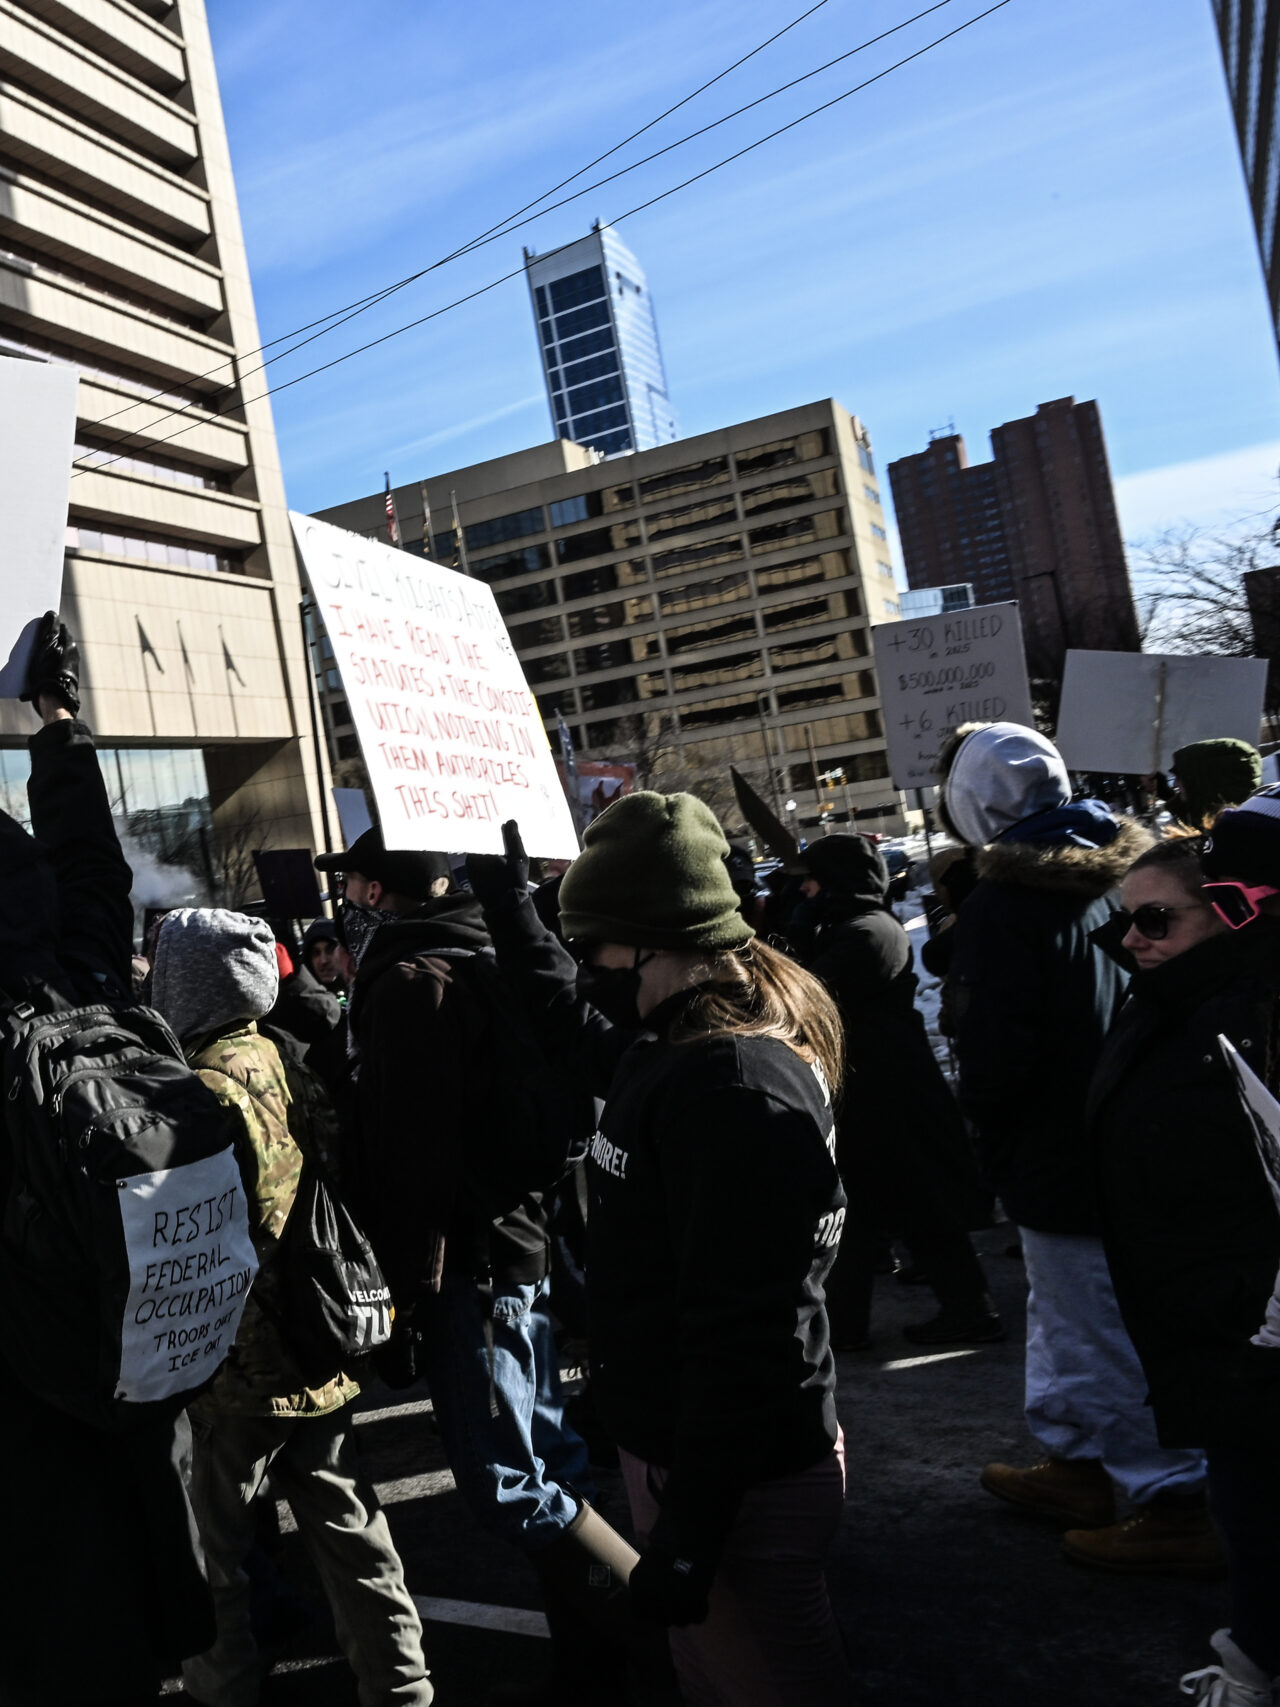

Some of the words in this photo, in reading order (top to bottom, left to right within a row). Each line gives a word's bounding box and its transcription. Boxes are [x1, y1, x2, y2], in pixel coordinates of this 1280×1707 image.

[329, 604, 353, 637] I
[351, 608, 401, 650] HAVE
[405, 620, 450, 664] READ
[452, 635, 489, 671] THE
[944, 614, 1003, 643] KILLED
[350, 652, 435, 697] STATUTES
[446, 674, 479, 708] THE
[946, 696, 1007, 720] KILLED
[433, 711, 509, 752] NOTHING
[508, 722, 535, 759] IN
[378, 742, 433, 777] THEM
[436, 751, 529, 788] AUTHORIZES
[395, 785, 449, 820] THIS
[452, 790, 499, 822] SHIT!
[153, 1186, 237, 1248] RESIST
[142, 1244, 231, 1293] FEDERAL
[135, 1268, 251, 1325] OCCUPATION
[154, 1320, 210, 1352] TROOPS
[214, 1307, 237, 1331] OUT
[168, 1349, 200, 1372] ICE
[204, 1334, 224, 1356] OUT
